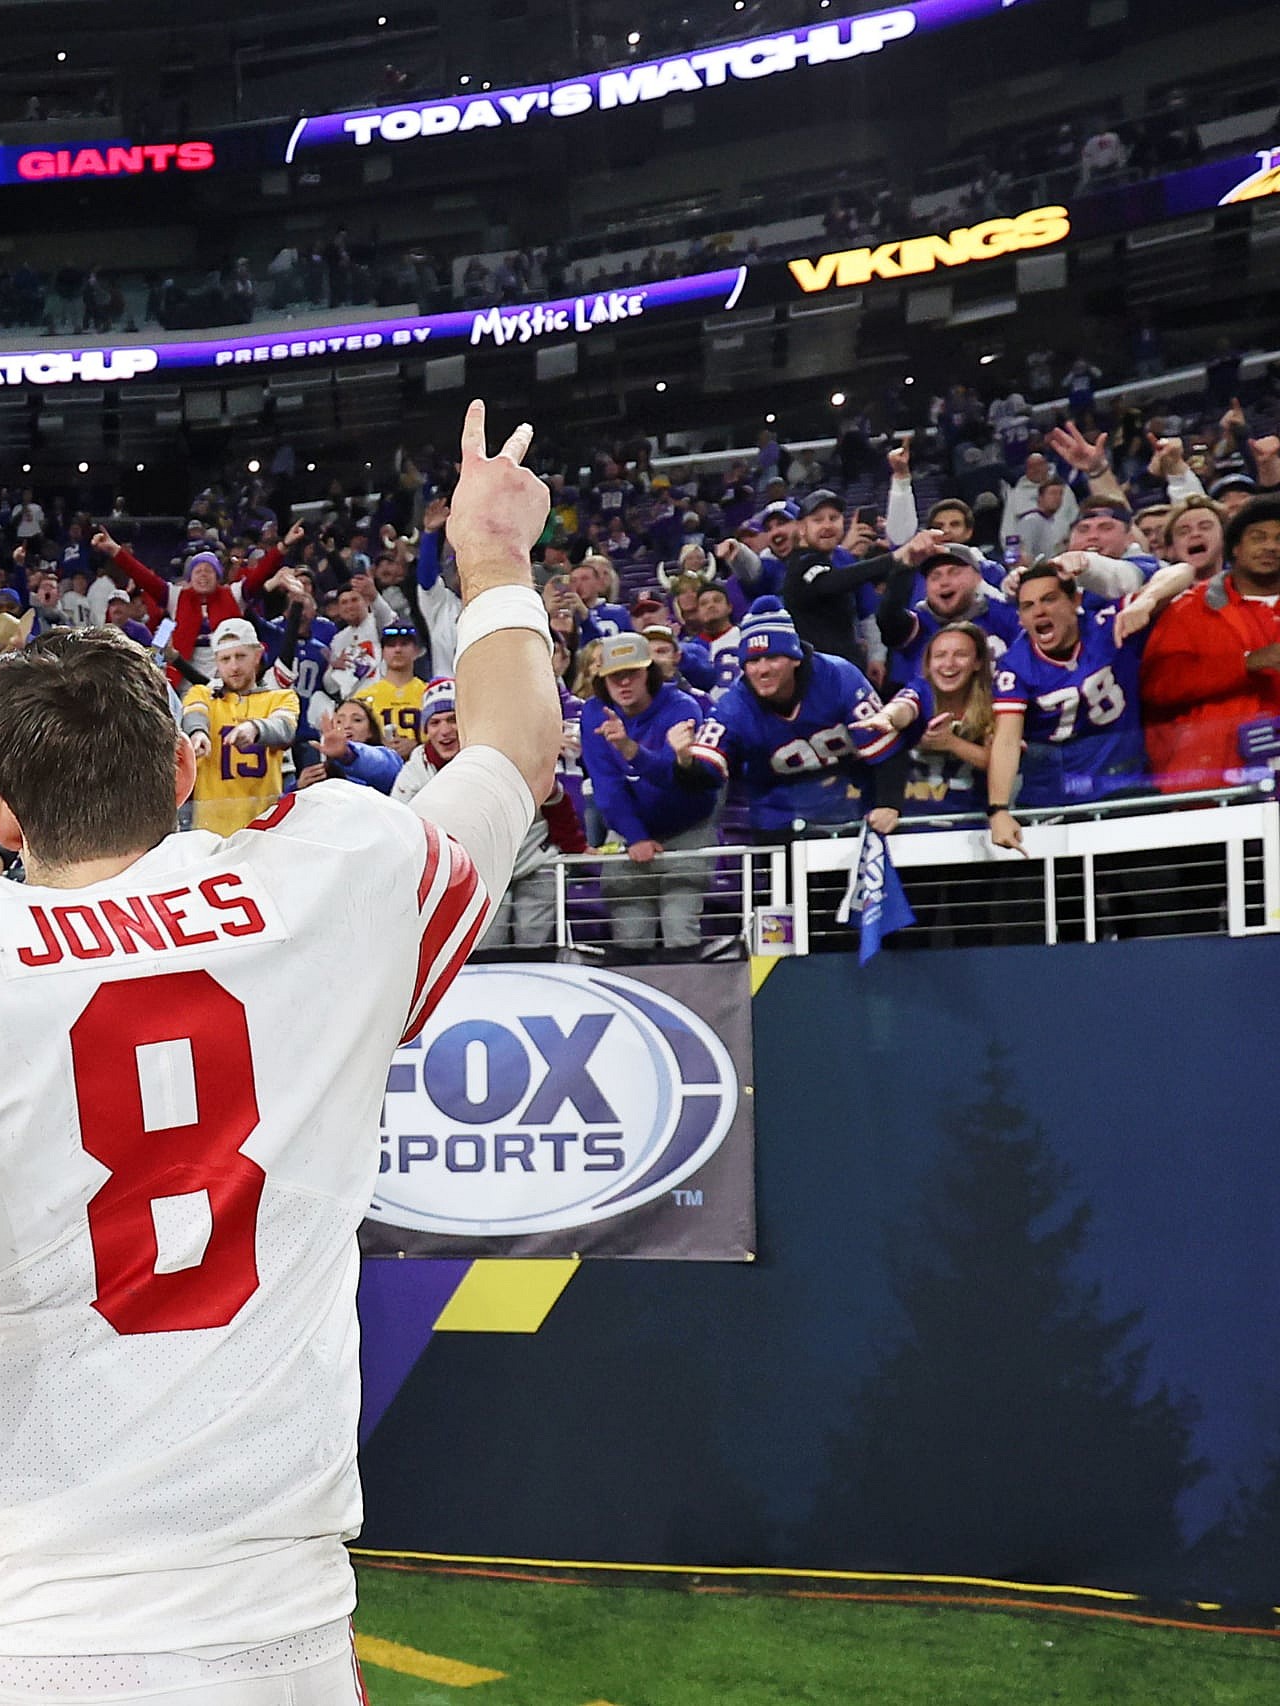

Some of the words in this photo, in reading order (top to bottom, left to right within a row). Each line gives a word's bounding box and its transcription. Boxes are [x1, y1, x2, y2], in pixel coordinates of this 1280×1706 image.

[344, 82, 593, 146] TODAY'S
[599, 10, 917, 109] MATCHUP
[18, 142, 216, 180] GIANTS
[787, 205, 1071, 293] VIKINGS
[215, 332, 383, 366] PRESENTED
[392, 327, 432, 345] BY
[380, 707, 422, 744] 19
[1037, 665, 1126, 742] 78
[17, 872, 266, 967] JONES
[69, 968, 267, 1336] 8
[672, 1189, 704, 1207] TM
